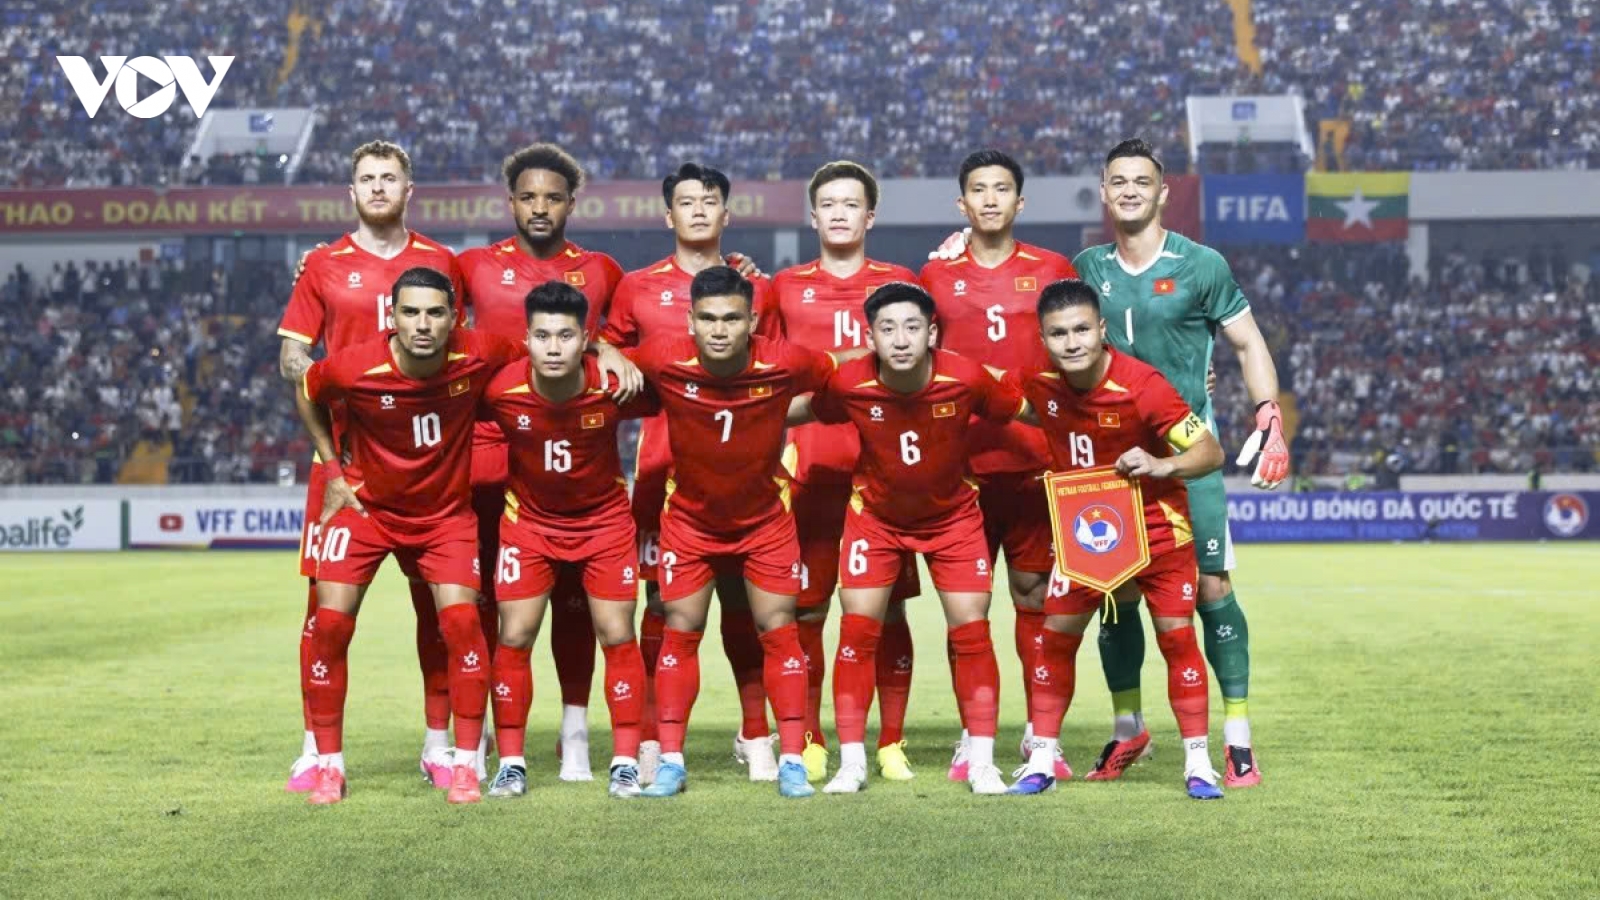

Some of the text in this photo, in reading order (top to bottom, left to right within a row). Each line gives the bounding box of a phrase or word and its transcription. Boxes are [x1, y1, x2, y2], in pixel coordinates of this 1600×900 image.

[0, 201, 74, 225] HAO
[1217, 196, 1290, 222] FIFA
[834, 310, 860, 348] 14
[986, 304, 1006, 342] 5
[1125, 308, 1134, 346] 1
[412, 412, 442, 448] 10
[714, 409, 733, 443] 7
[544, 439, 572, 473] 15
[900, 430, 921, 466] 6
[1069, 432, 1096, 468] 19
[196, 509, 236, 532] VFF
[321, 526, 352, 563] 10
[848, 539, 869, 576] 6
[497, 547, 521, 584] 15
